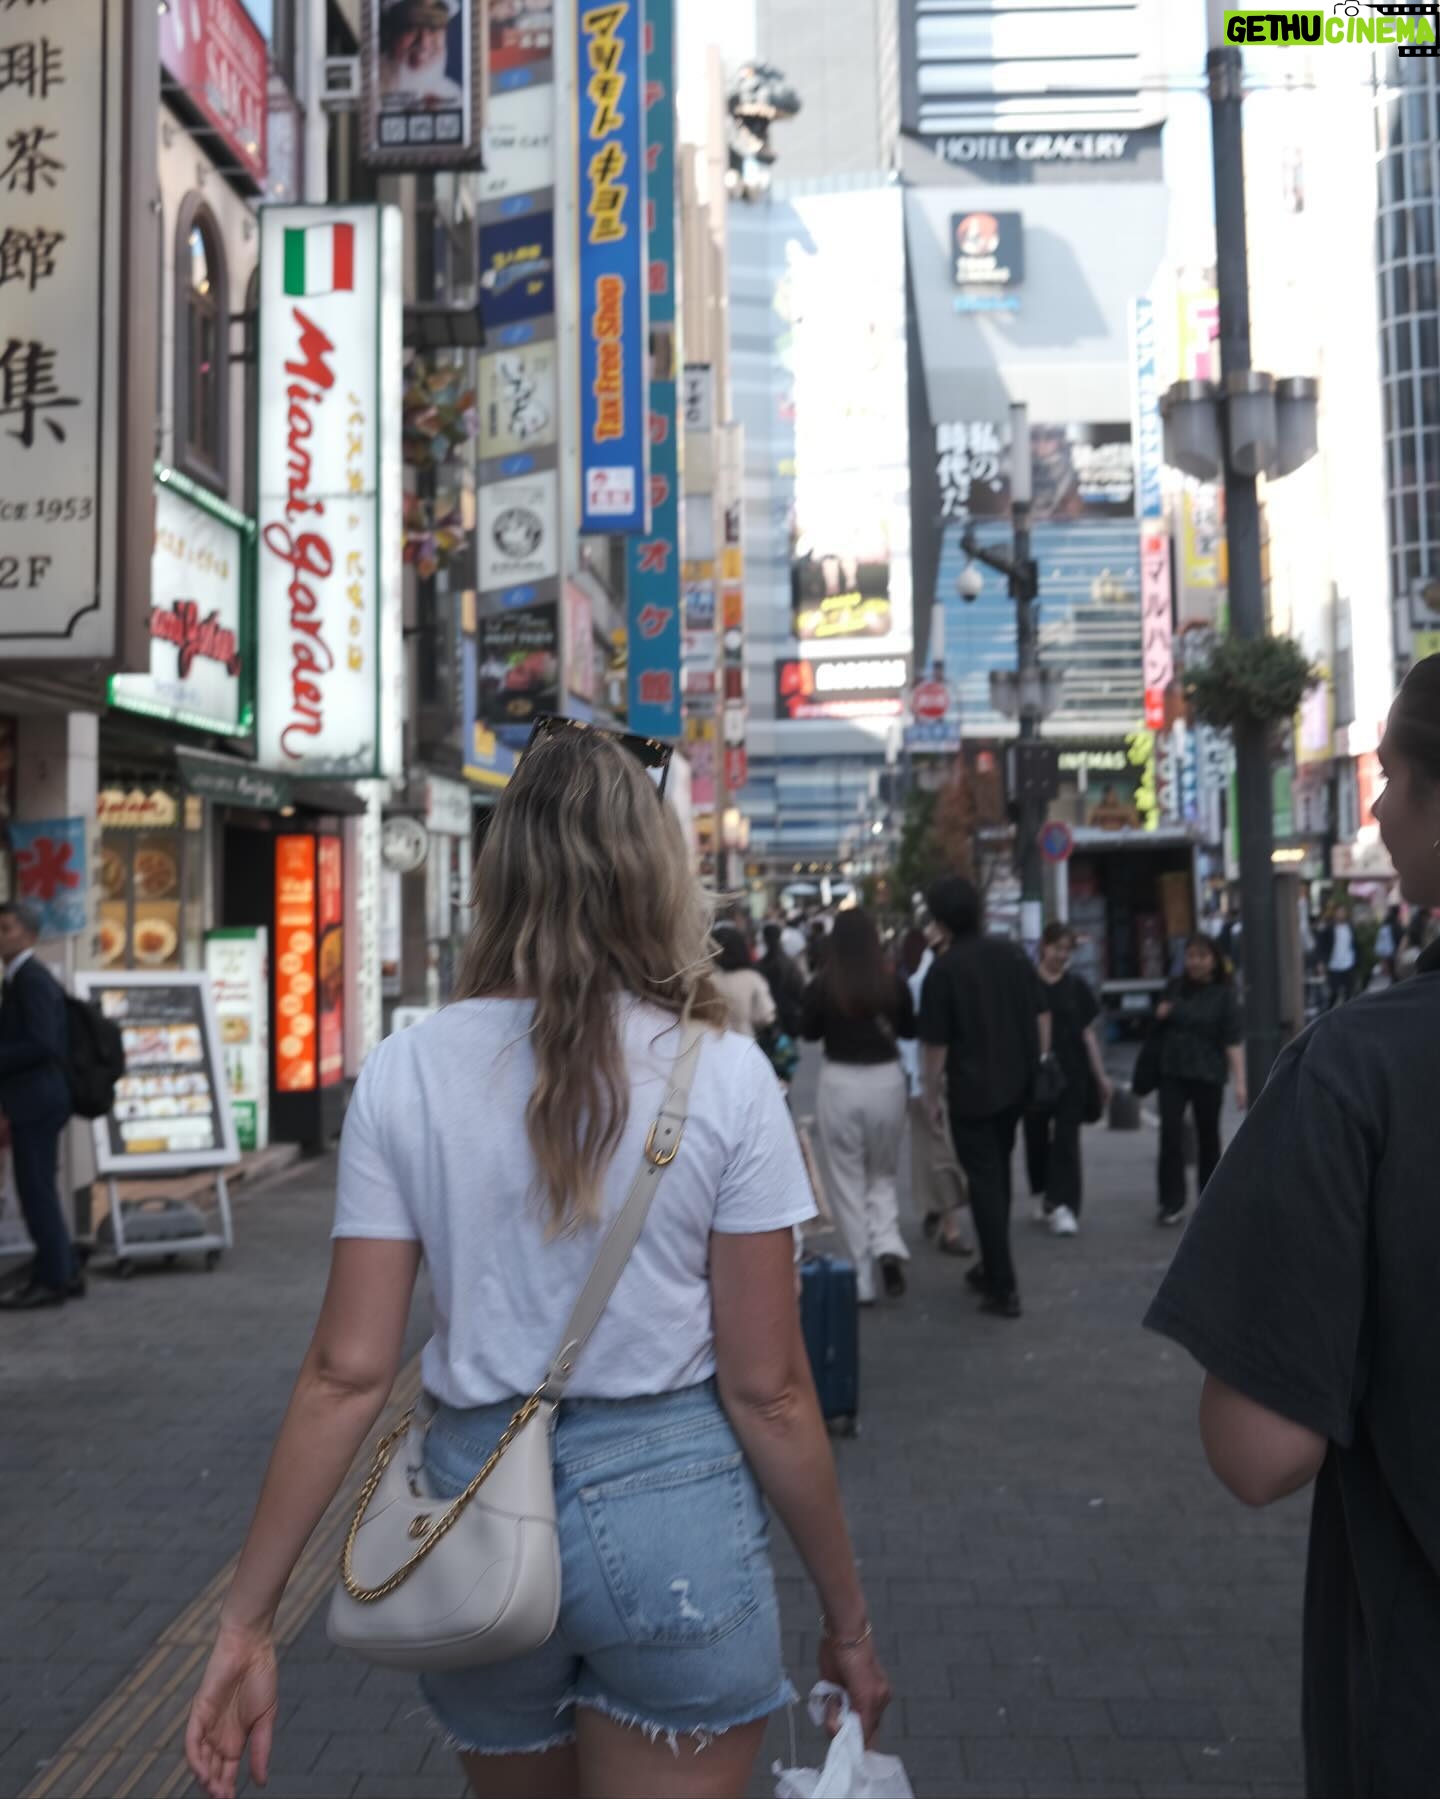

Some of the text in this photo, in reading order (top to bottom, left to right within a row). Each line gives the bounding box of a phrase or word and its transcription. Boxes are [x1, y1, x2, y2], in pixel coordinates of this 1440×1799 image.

[0, 0, 65, 291] 琲茶館
[936, 132, 1128, 161] HOTEL GRACERY
[34, 497, 93, 522] 1953
[263, 306, 335, 760] Miami Garden
[0, 556, 52, 589] 2F
[1146, 559, 1168, 686] マルハン
